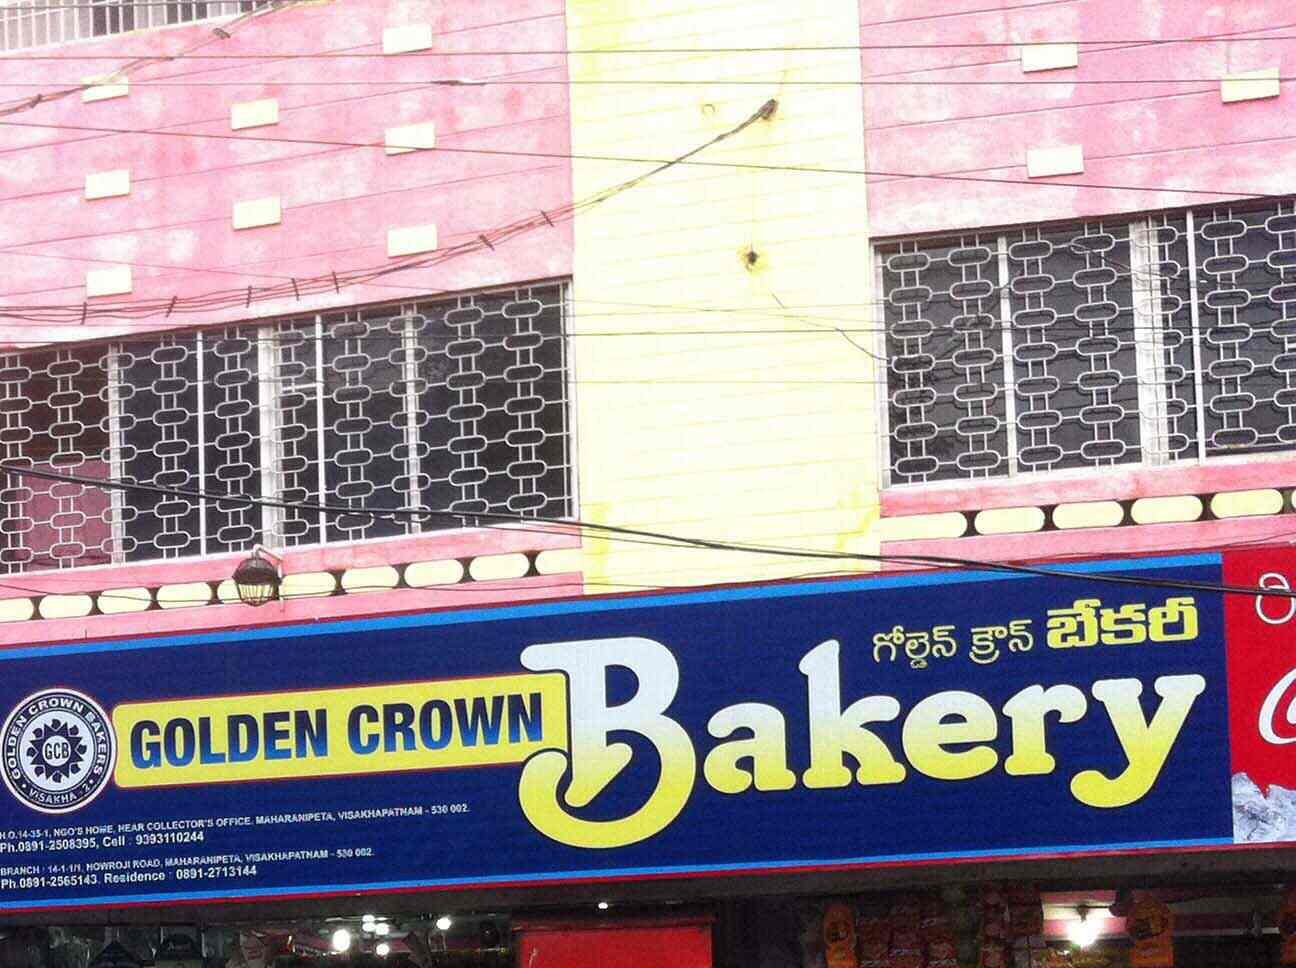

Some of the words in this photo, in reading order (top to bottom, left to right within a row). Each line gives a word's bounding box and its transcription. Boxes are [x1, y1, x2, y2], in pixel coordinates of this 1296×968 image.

[1046, 596, 1199, 649] బేకరీ
[7, 715, 28, 780] GOLDEN
[28, 697, 84, 716] CROWN
[84, 711, 107, 776] BAKERS
[130, 707, 329, 768] GOLDEN
[347, 692, 543, 756] CROWN
[519, 637, 1205, 849] Bakery
[44, 742, 70, 760] GCB
[118, 822, 146, 833] NEAR
[146, 818, 214, 831] COLLECTOR'S
[337, 805, 423, 821] VISAKHAPATNAM
[103, 834, 126, 847] Cell
[0, 864, 40, 877] BRANCH
[245, 849, 329, 863] VISAKHAPATNAM
[104, 870, 166, 884] Residence
